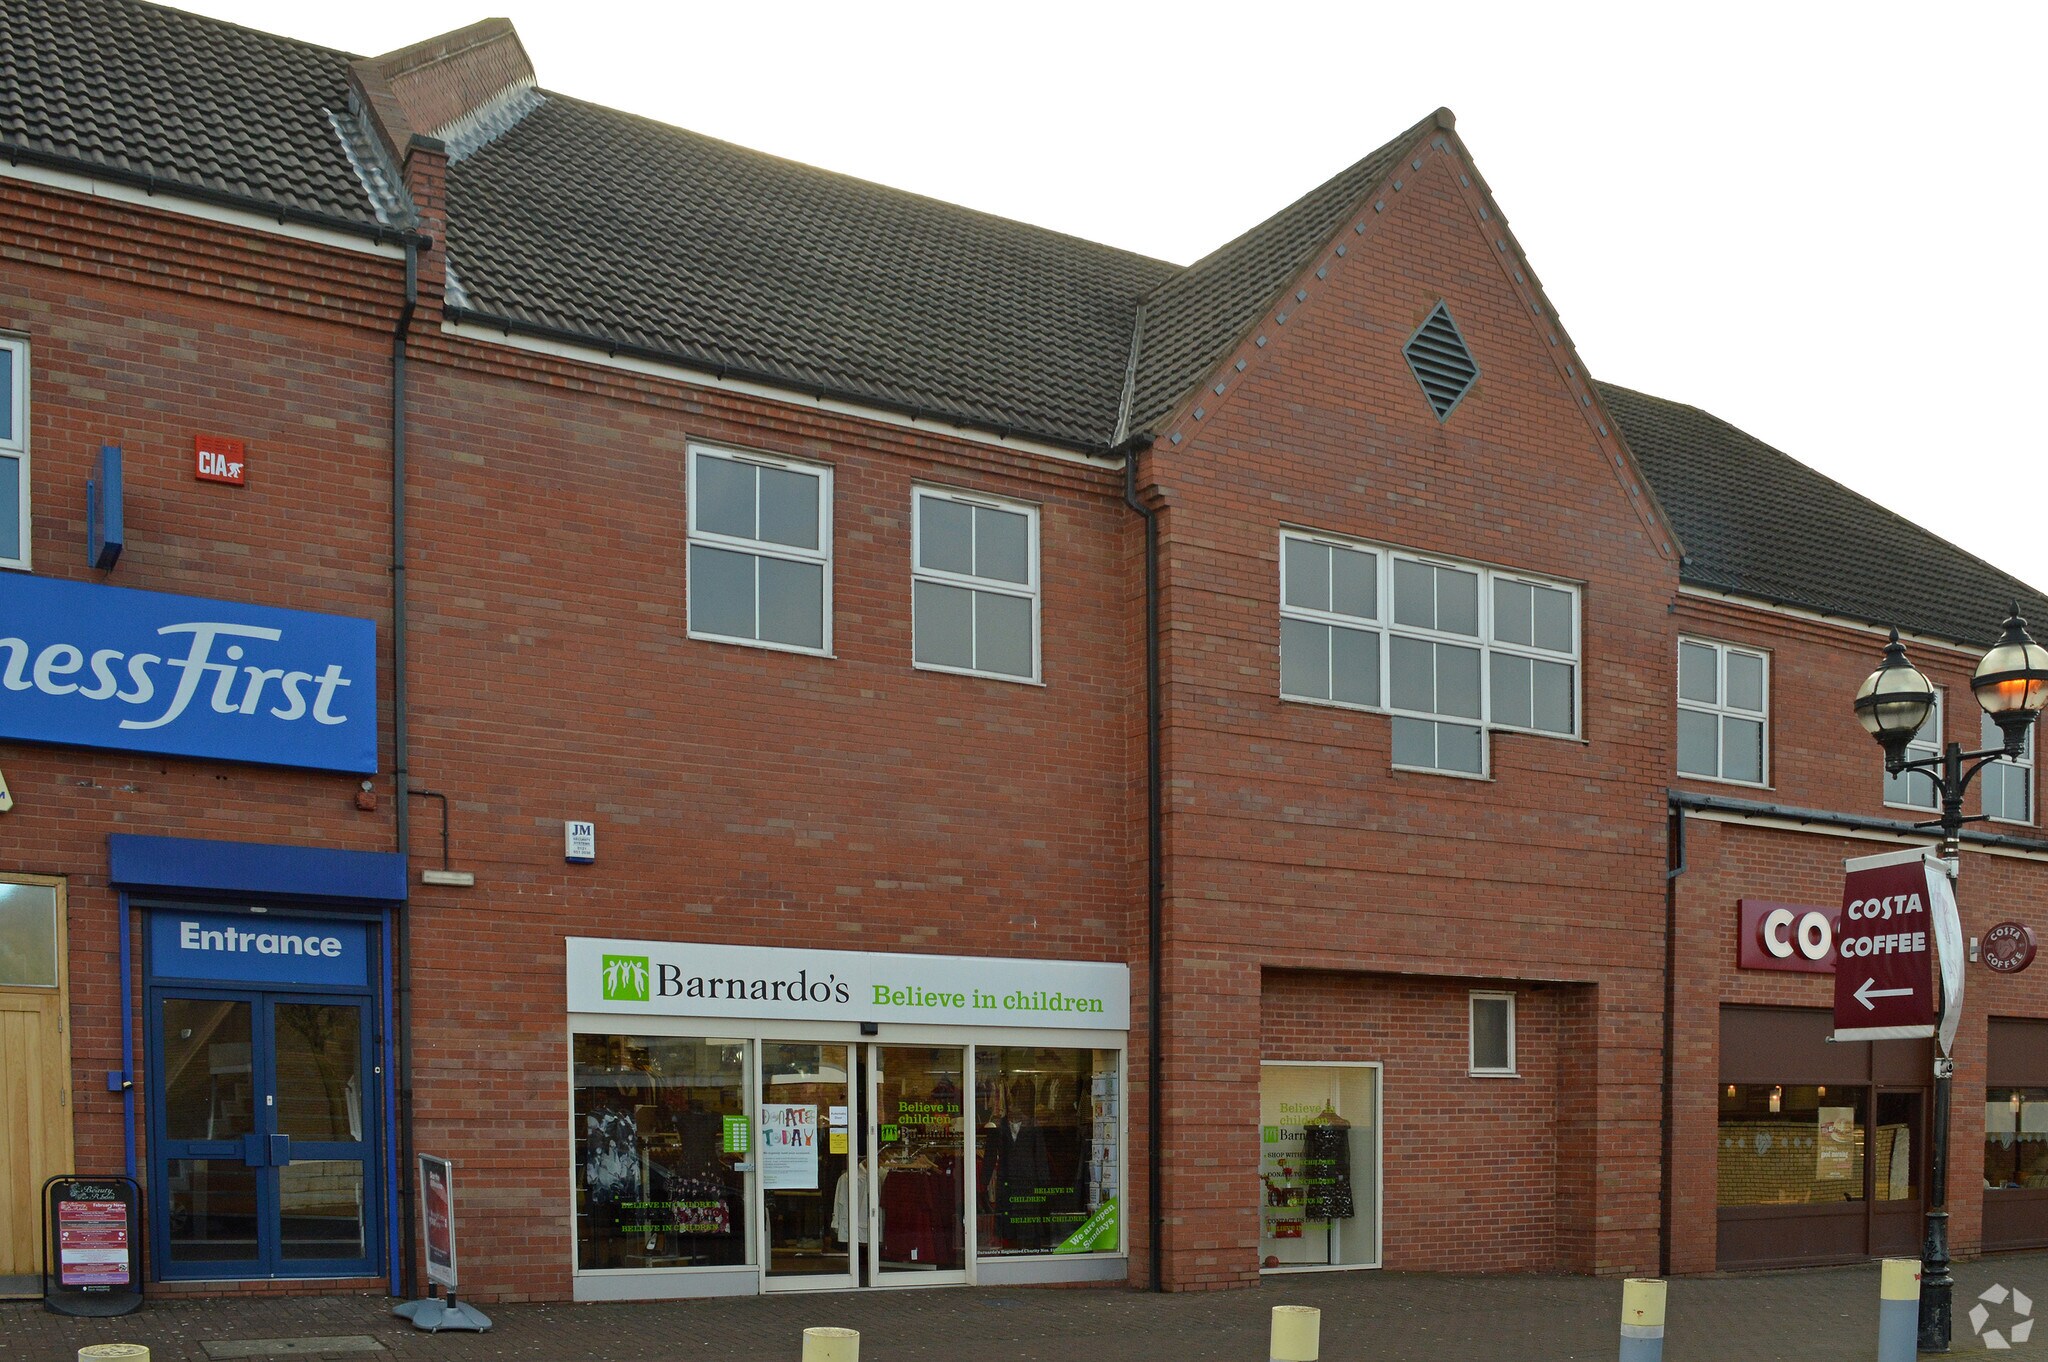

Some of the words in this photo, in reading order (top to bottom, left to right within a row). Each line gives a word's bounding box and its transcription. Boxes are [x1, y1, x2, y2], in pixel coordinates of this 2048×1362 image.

[199, 451, 227, 476] CIA
[572, 824, 591, 836] JM
[1848, 893, 1923, 920] COSTA
[180, 921, 343, 958] Entrance
[1761, 908, 1841, 961] CO
[1840, 931, 1926, 958] COFFEE
[1990, 927, 2021, 941] COSTA
[1987, 952, 2024, 969] COFFEE
[656, 963, 850, 1004] Barnardo's
[872, 984, 965, 1009] Believe
[972, 989, 998, 1010] in
[1003, 990, 1104, 1013] children
[898, 1101, 944, 1113] Believe
[946, 1102, 960, 1112] in
[898, 1113, 951, 1124] children
[1280, 1103, 1320, 1114] Believe
[1280, 1115, 1329, 1126] children
[674, 1223, 719, 1231] CHILDREN
[1069, 1233, 1084, 1246] We
[1083, 1221, 1096, 1235] are
[1095, 1204, 1116, 1222] open
[1082, 1217, 1115, 1249] Sundays
